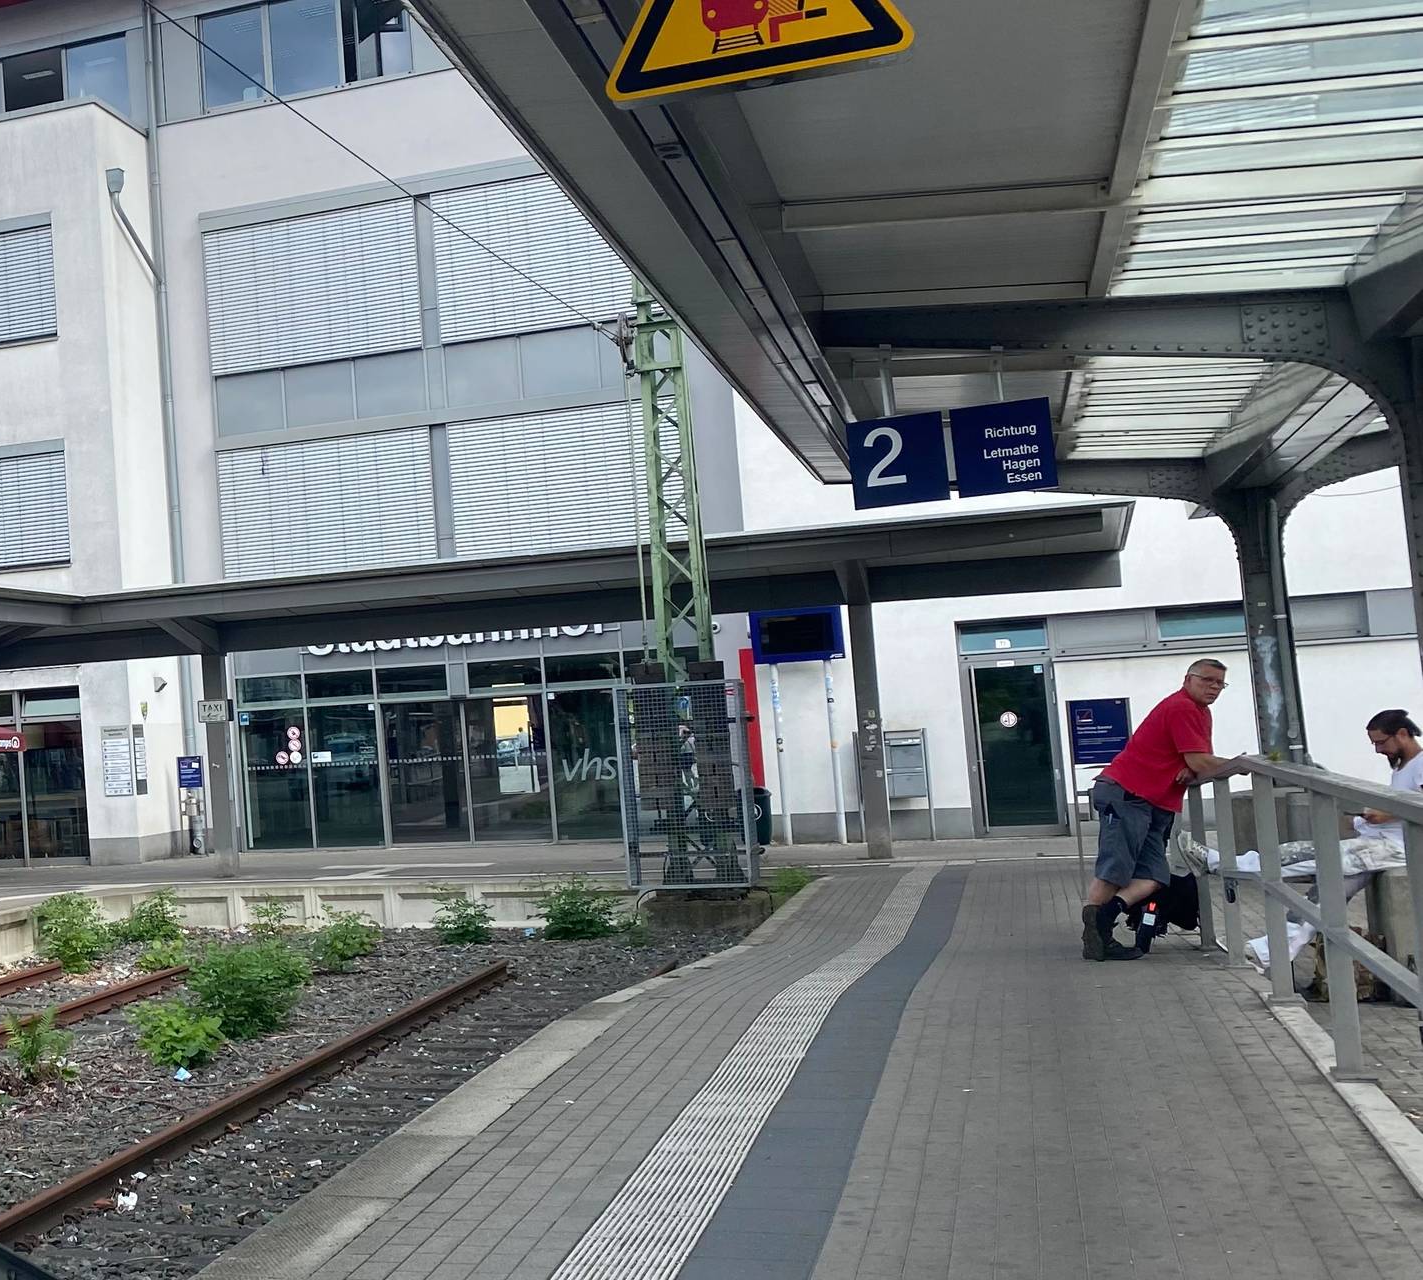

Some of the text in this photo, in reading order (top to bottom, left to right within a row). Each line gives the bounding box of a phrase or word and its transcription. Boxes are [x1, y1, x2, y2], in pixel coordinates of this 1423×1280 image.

[984, 424, 1037, 438] Richtung
[863, 427, 907, 488] 2
[983, 444, 1039, 459] Letmathe
[1002, 458, 1041, 470] Hagen
[1006, 471, 1042, 484] Essen
[202, 704, 222, 712] TAXI
[562, 748, 618, 781] vhs
